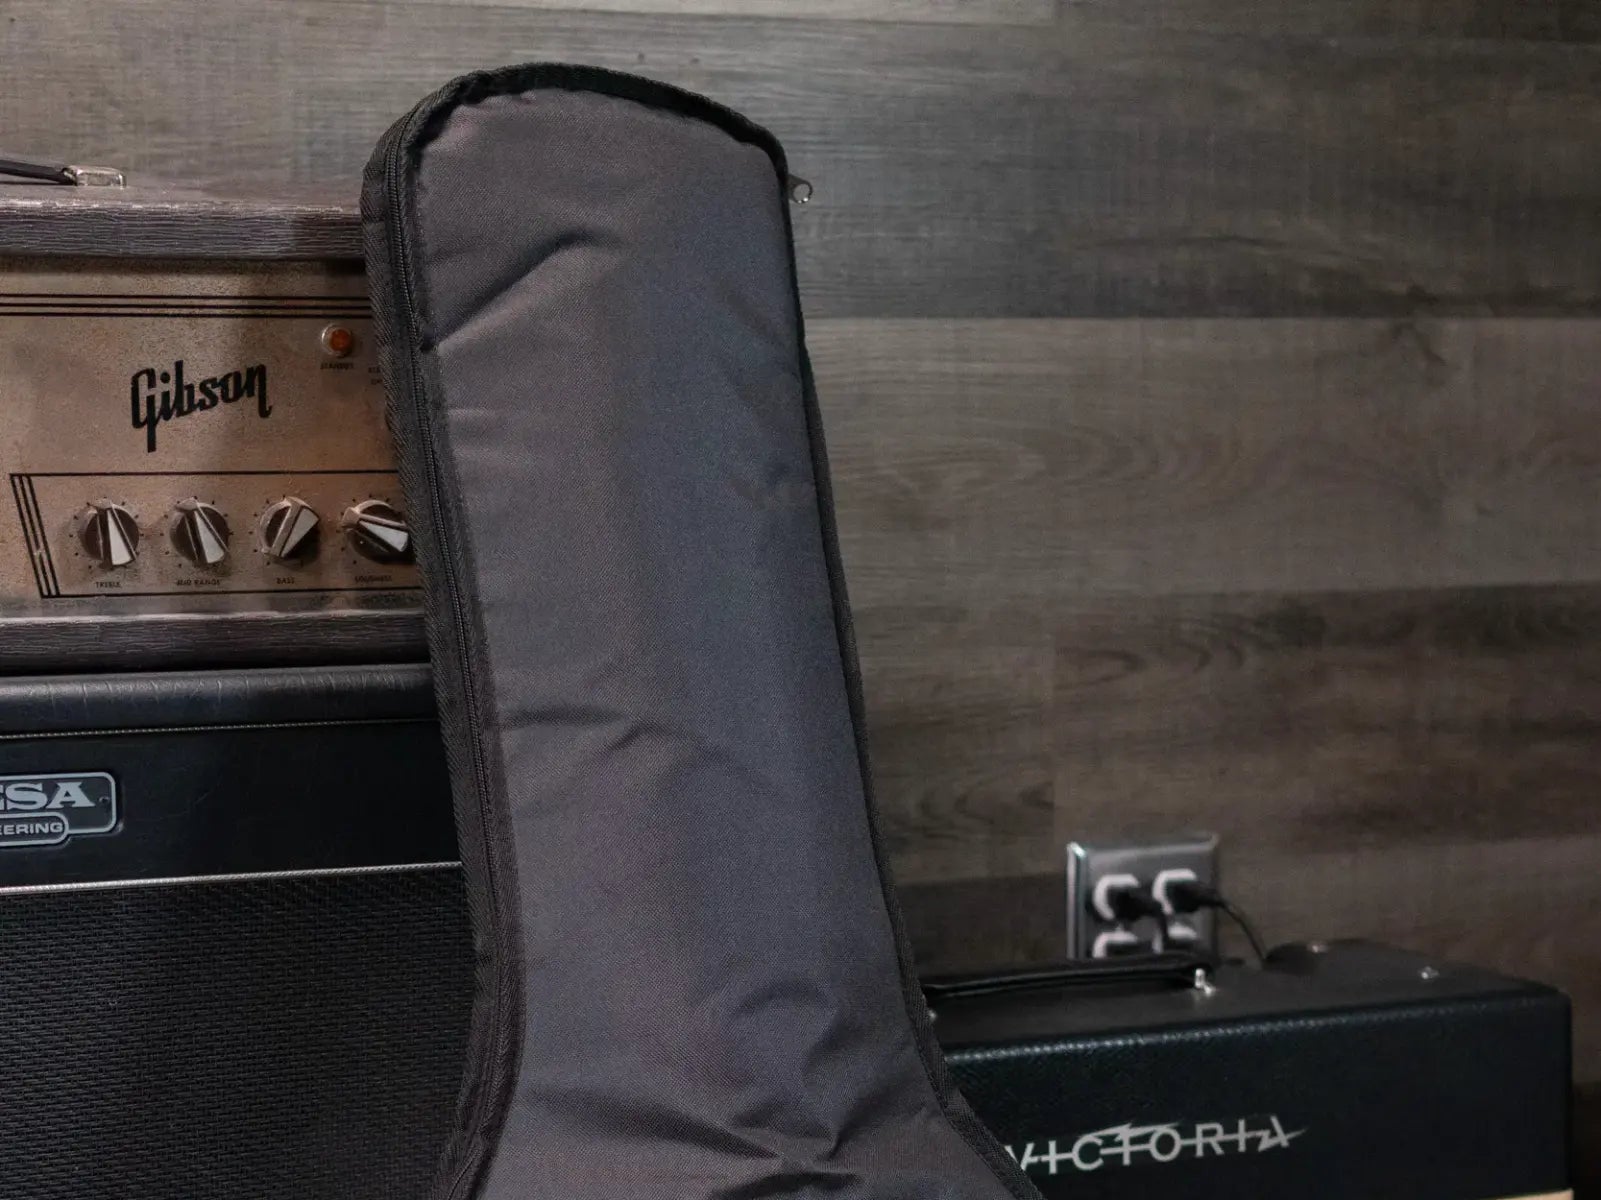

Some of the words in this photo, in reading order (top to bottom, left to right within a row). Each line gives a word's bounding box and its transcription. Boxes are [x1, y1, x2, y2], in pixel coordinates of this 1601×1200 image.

[130, 359, 272, 453] Gibson
[276, 576, 295, 585] BASS
[0, 781, 96, 811] SA
[0, 822, 63, 836] ERING
[1004, 1115, 1307, 1175] VICTORIA
